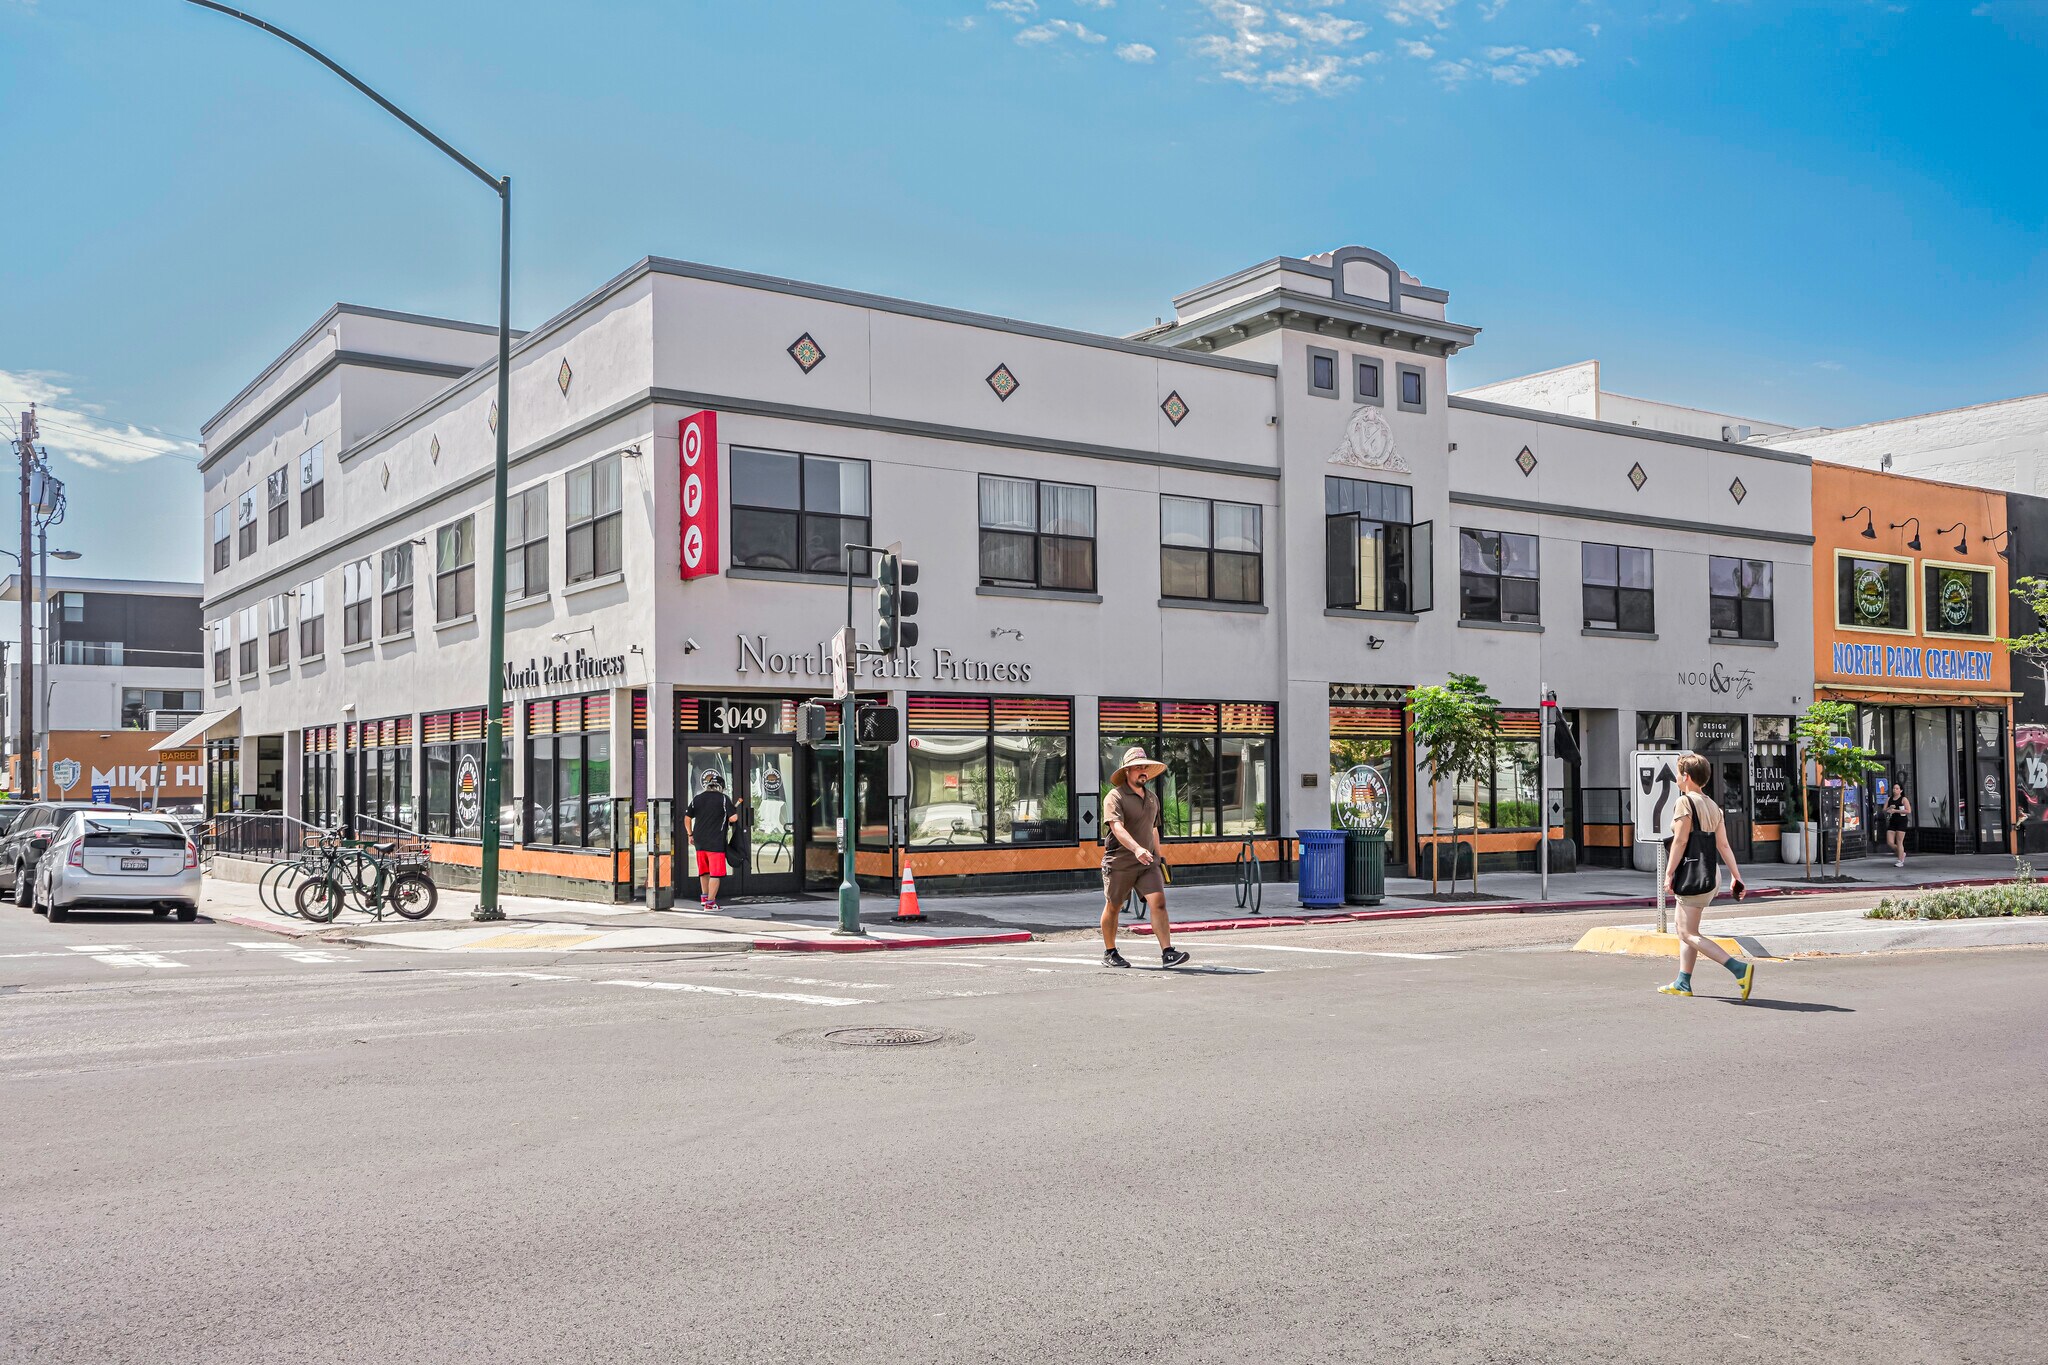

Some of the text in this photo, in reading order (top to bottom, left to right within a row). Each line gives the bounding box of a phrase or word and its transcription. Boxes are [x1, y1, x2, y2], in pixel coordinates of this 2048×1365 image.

[689, 484, 698, 508] P
[503, 648, 625, 690] North Park Fitness
[737, 634, 1032, 682] North Park Fitness
[1833, 641, 1993, 681] NORTH PARK CREAMERY
[714, 707, 767, 729] 3049
[161, 752, 196, 760] BARBER
[91, 765, 166, 787] MIKE
[1756, 768, 1785, 778] ETAIL
[1367, 773, 1386, 796] PARK
[1755, 782, 1785, 791] HERAPY
[1930, 796, 1937, 804] A
[1343, 811, 1383, 828] FITNESS
